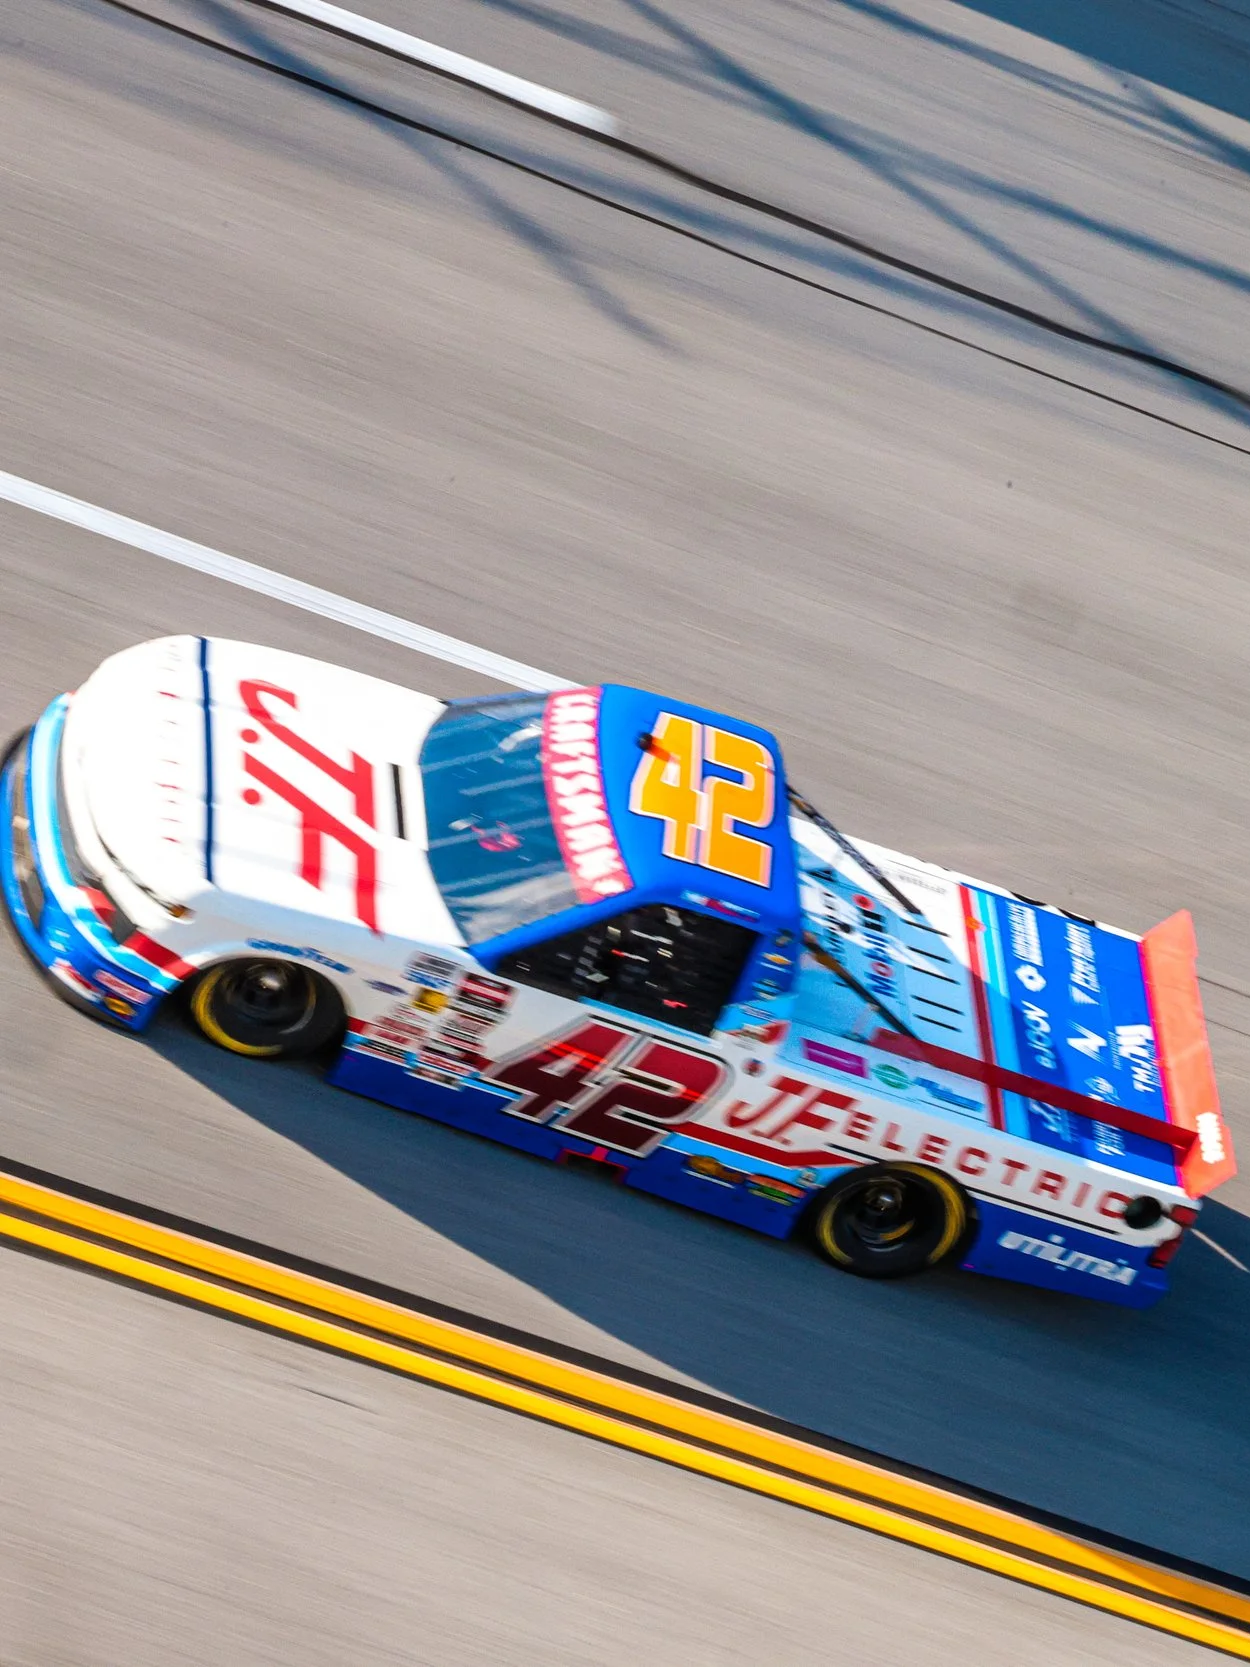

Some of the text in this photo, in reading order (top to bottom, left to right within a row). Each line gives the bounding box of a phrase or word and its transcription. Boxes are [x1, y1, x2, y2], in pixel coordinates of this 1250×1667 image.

[628, 710, 776, 889] 42
[483, 1012, 737, 1158] 42
[842, 1109, 1132, 1220] ELECTRIC
